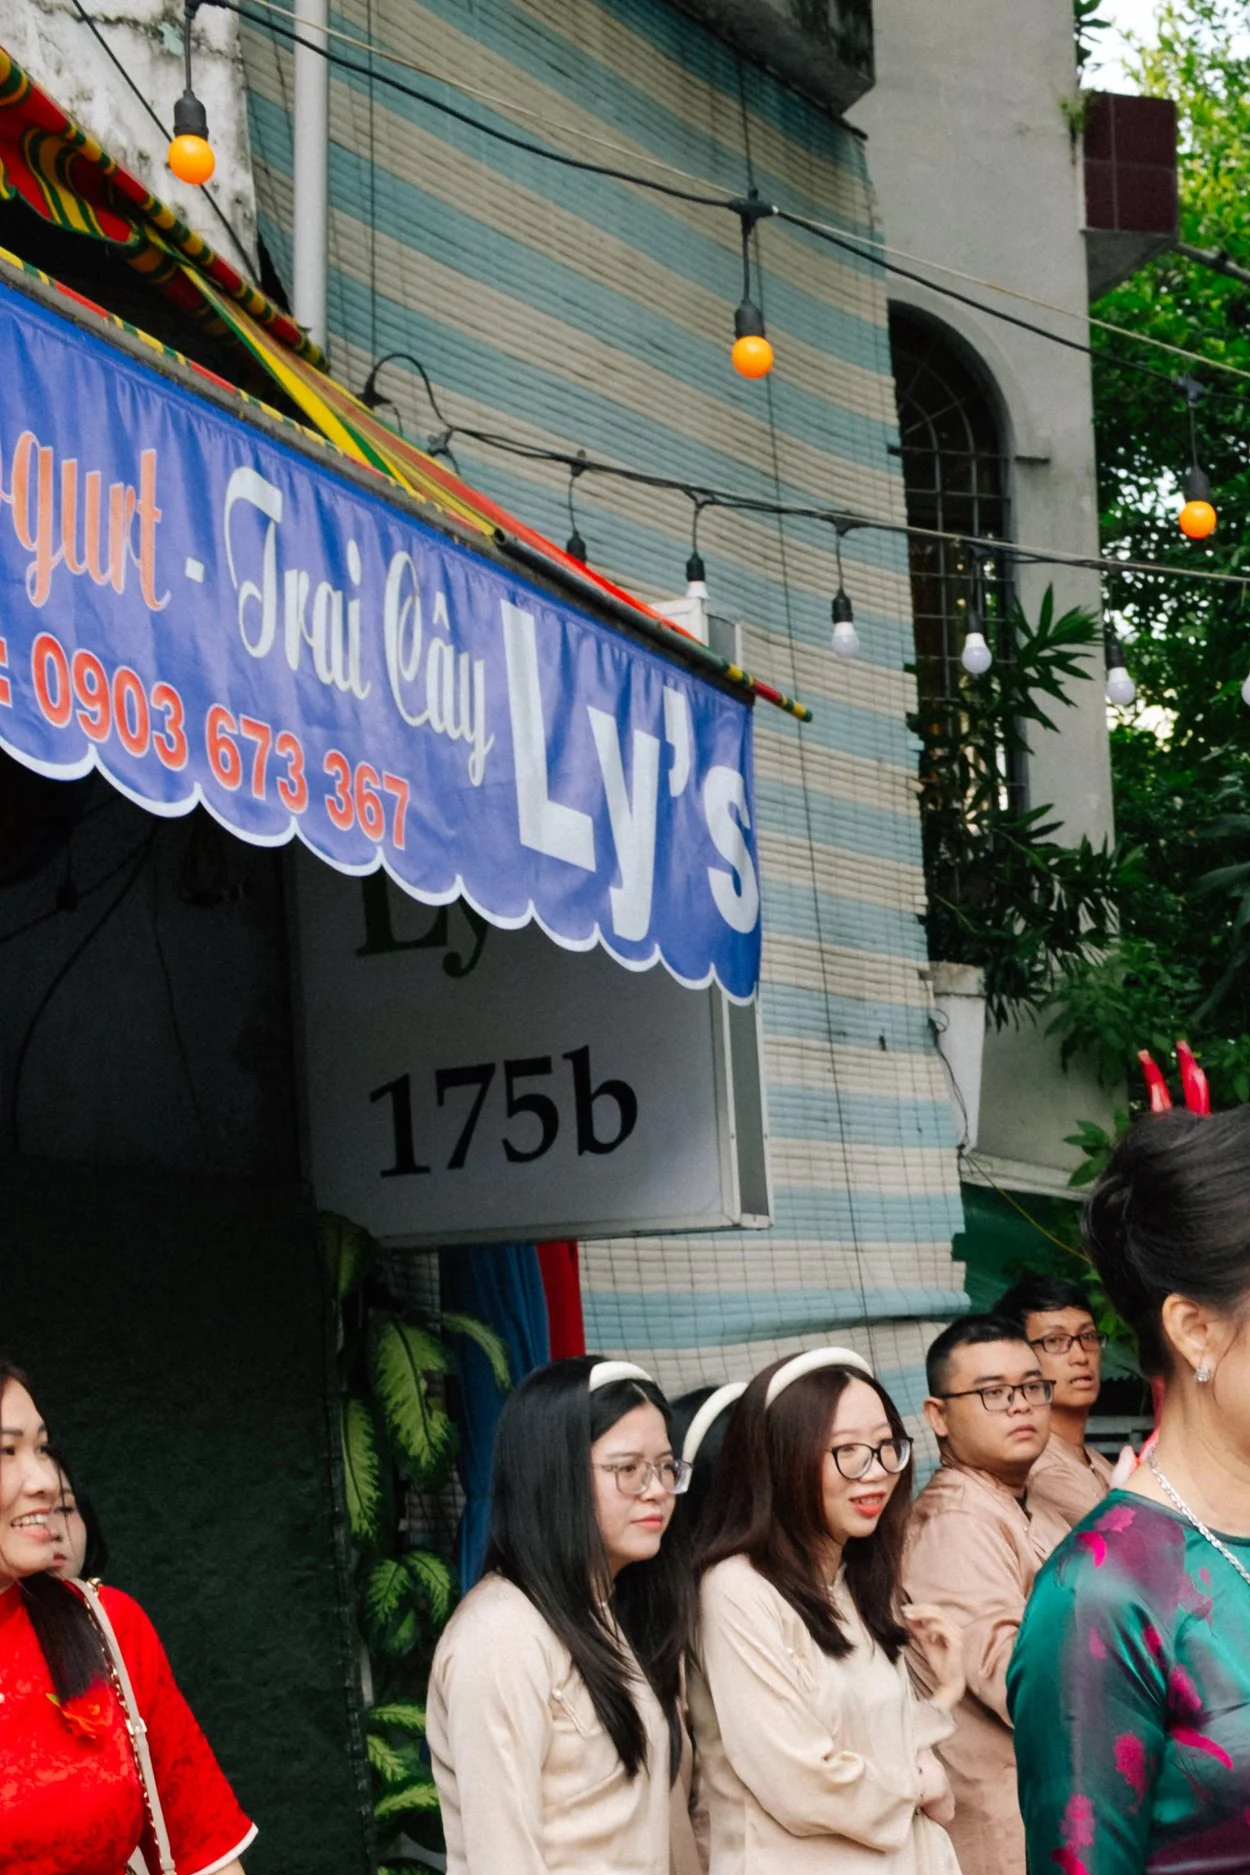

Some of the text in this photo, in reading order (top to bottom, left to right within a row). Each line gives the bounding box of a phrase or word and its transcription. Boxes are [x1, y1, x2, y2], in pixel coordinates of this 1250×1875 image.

[0, 431, 171, 612] gurt
[223, 466, 370, 701] Trai
[384, 551, 496, 786] Cây
[500, 599, 760, 943] Ly's
[30, 632, 188, 772] 0903
[205, 703, 309, 815] 673
[323, 751, 411, 850] 367
[369, 1045, 638, 1178] 175b
